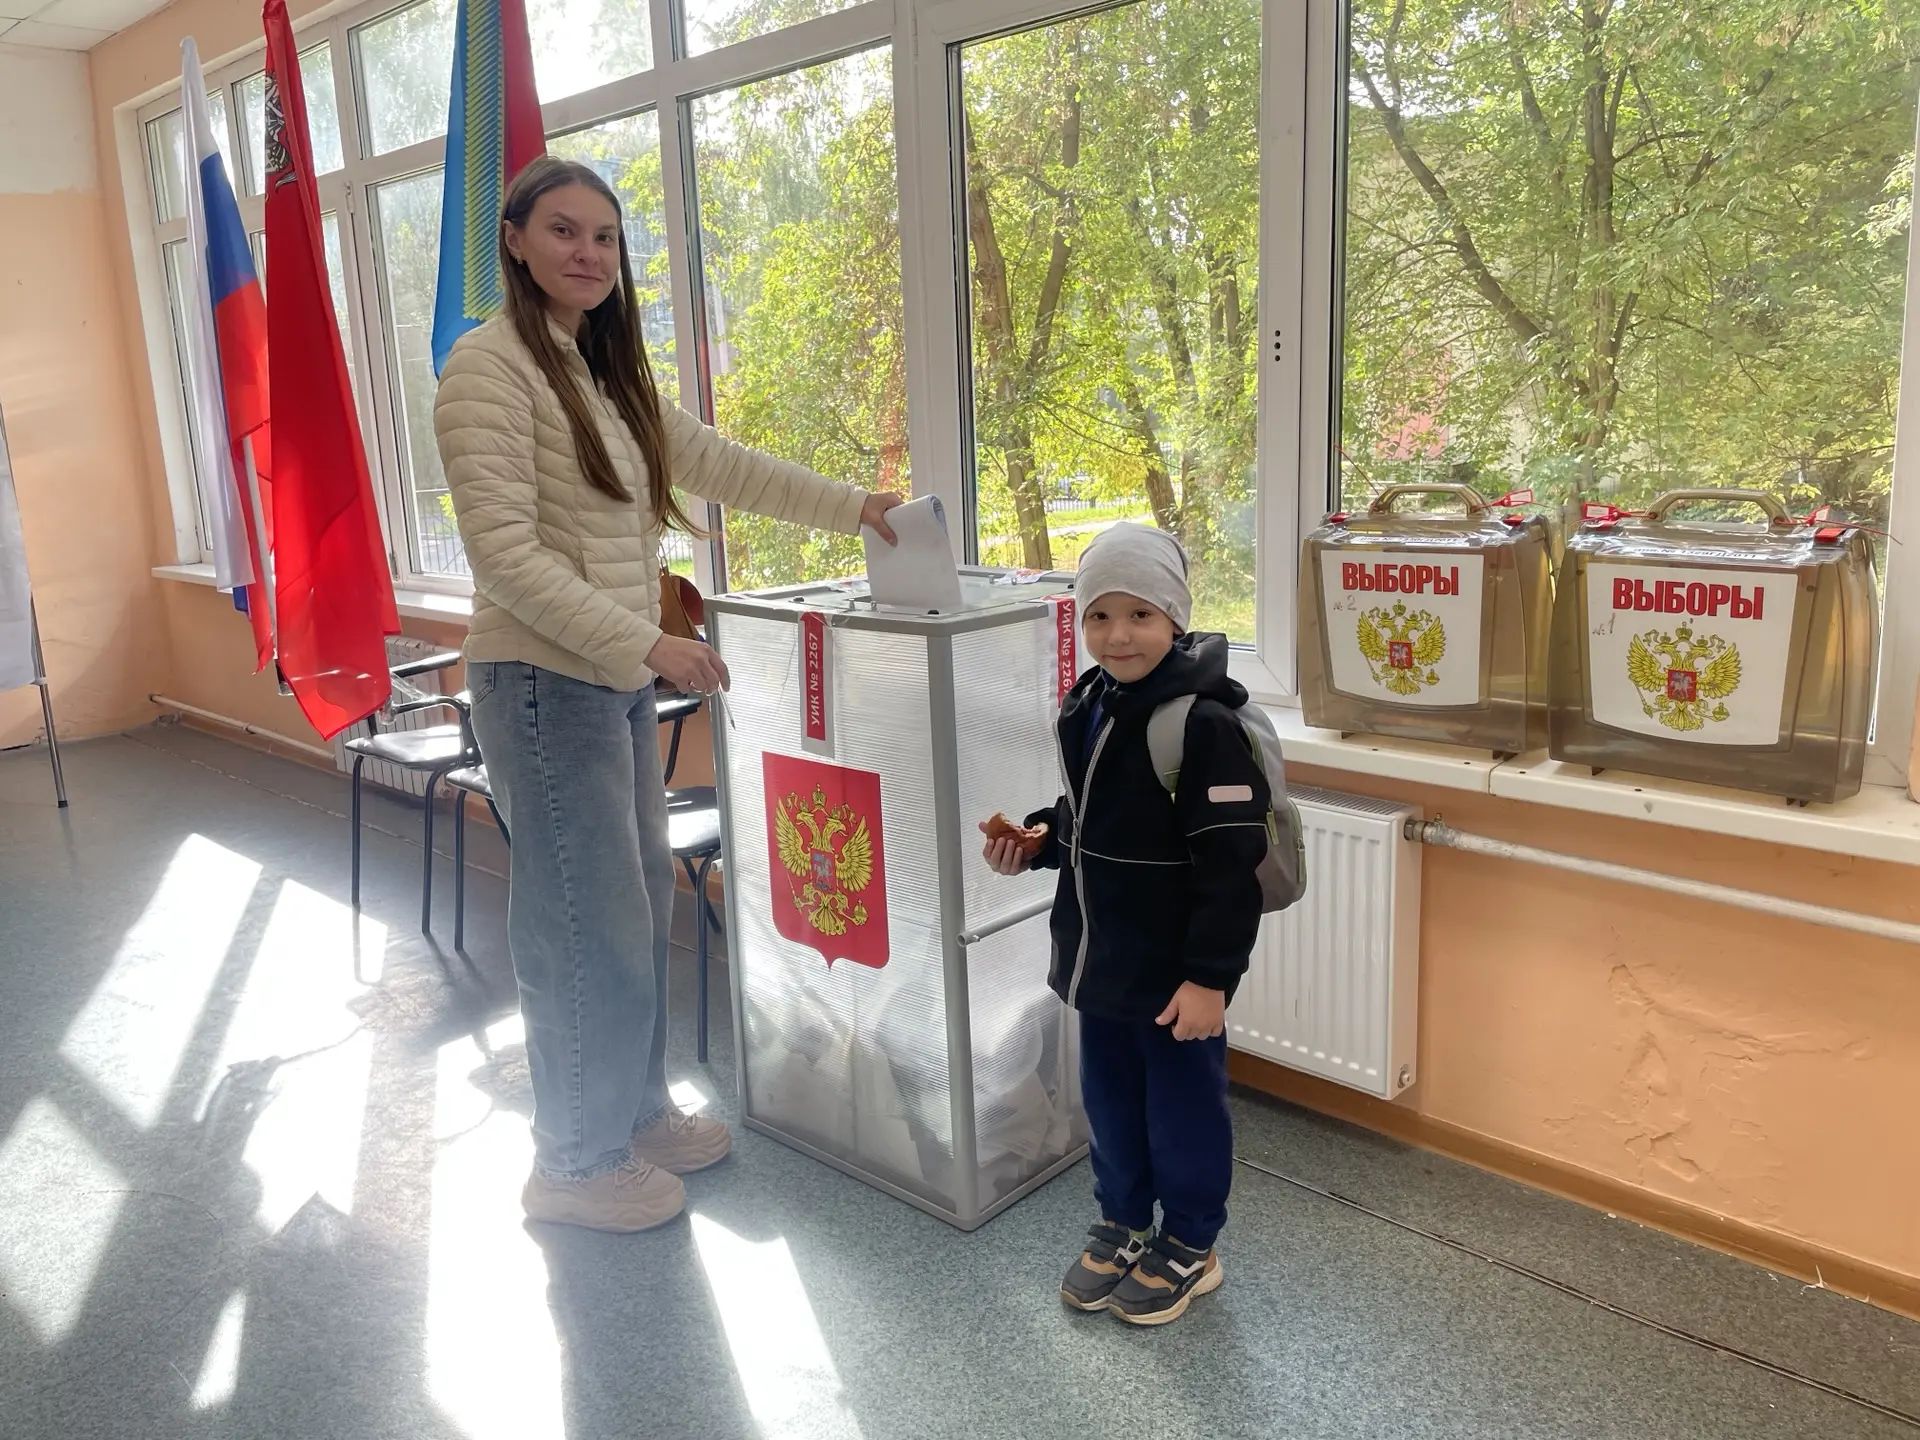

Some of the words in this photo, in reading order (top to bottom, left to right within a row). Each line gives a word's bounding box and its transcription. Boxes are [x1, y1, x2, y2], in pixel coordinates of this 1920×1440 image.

[1342, 562, 1459, 596] ВЫБОРЫ
[1612, 577, 1765, 620] ВЫБОРЫ
[1062, 602, 1073, 633] УИК
[808, 632, 819, 669] 2267
[1062, 638, 1072, 656] №
[810, 673, 819, 691] №
[811, 695, 820, 726] УИК
